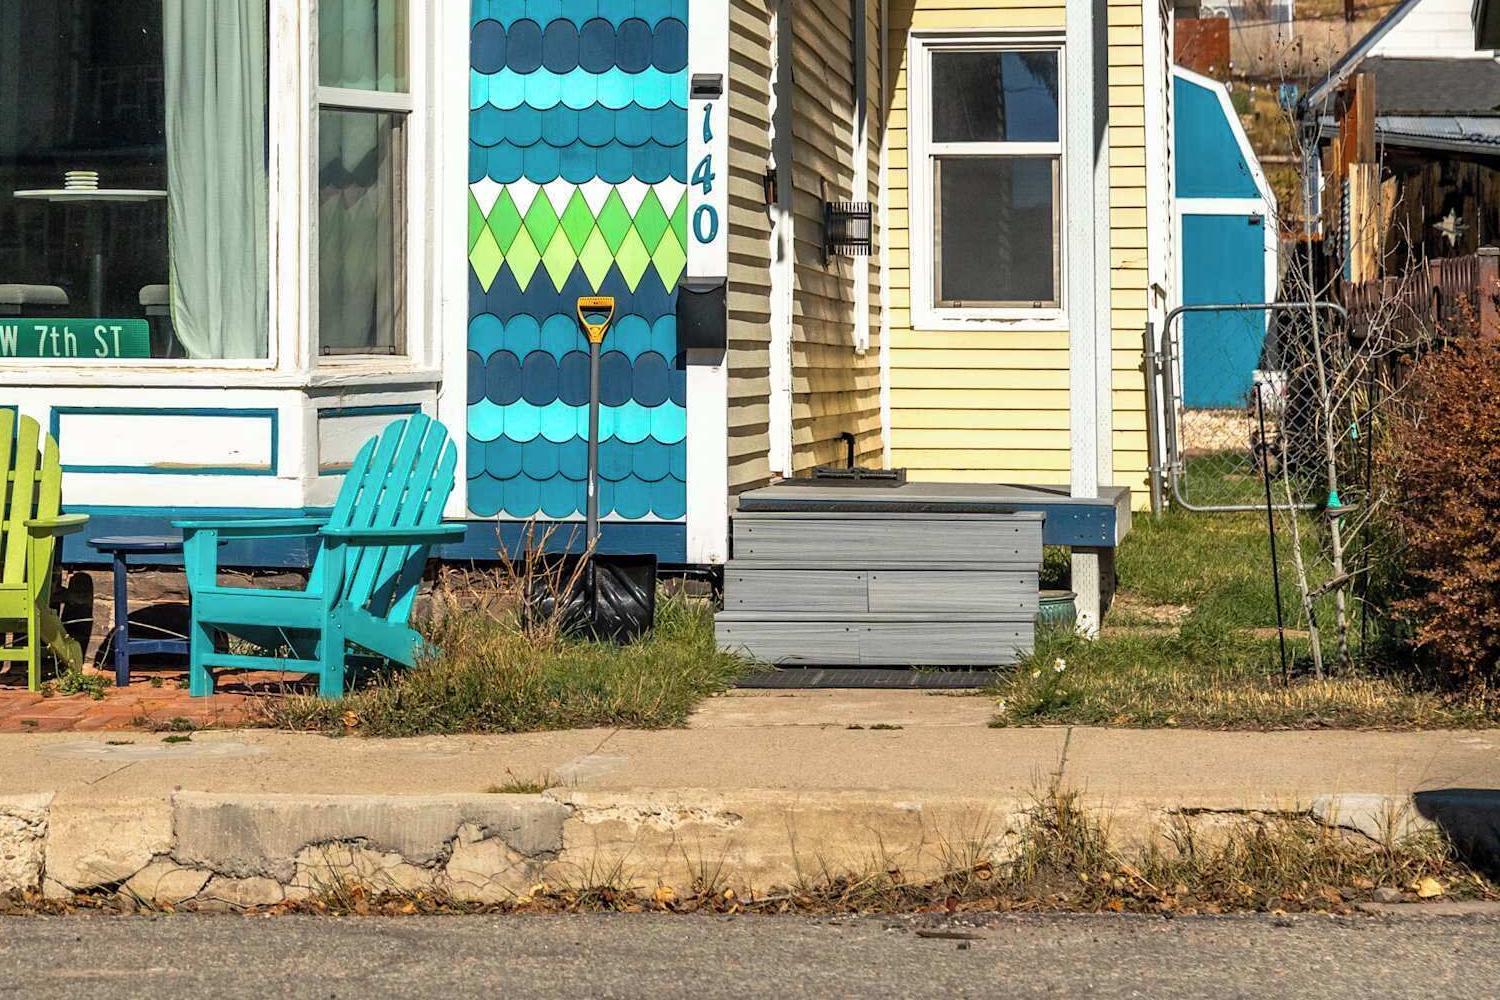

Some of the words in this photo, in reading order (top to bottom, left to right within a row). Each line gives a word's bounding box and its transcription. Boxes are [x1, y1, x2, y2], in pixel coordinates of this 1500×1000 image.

[691, 102, 719, 244] 140
[0, 325, 18, 357] W
[34, 325, 78, 357] 7th
[93, 325, 123, 357] ST
